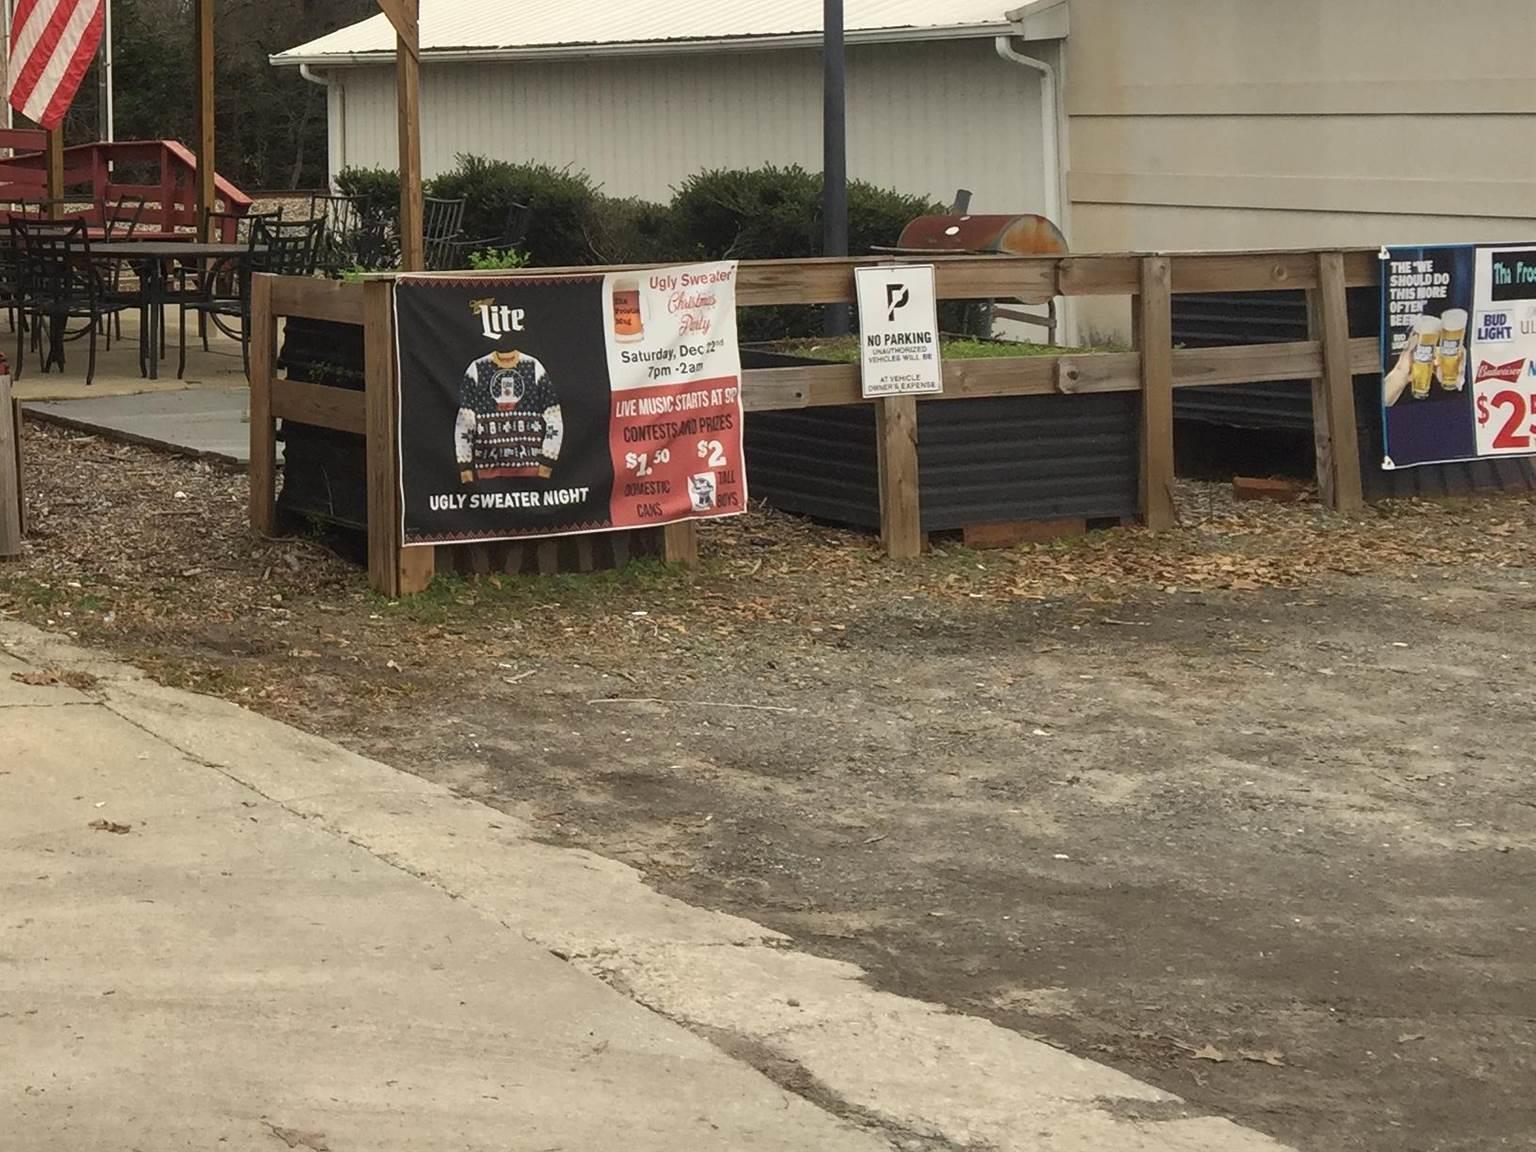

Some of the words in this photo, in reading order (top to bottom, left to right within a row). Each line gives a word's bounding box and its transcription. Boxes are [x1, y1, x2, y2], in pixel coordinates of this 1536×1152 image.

[1390, 261, 1412, 274] THE
[649, 274, 677, 291] Ugly
[681, 270, 732, 287] Sweater
[1390, 273, 1432, 287] SHOULD
[1433, 272, 1450, 285] DO
[1390, 287, 1416, 300] THIS
[1416, 286, 1447, 299] MORE
[479, 304, 525, 340] Lite
[1484, 313, 1507, 327] BUD
[867, 334, 881, 347] NO
[884, 331, 932, 346] PARKING
[1477, 326, 1512, 341] LIGHT
[621, 348, 677, 364] Saturday,
[679, 345, 704, 358] Dec
[872, 346, 928, 355] UNAUTHORIZED
[868, 355, 901, 363] VEHICLES
[648, 366, 671, 380] 7pm
[889, 374, 920, 382] VEHICLE
[616, 399, 637, 418] LIVE
[638, 396, 674, 416] MUSIC
[675, 390, 709, 412] STARTS
[711, 389, 723, 406] AT
[624, 421, 678, 443] CONTESTS
[699, 414, 733, 434] PRIZES
[697, 439, 727, 468] $2
[718, 470, 736, 485] TALL
[624, 480, 670, 497] DOMESTIC
[429, 494, 466, 511] UGLY
[469, 491, 540, 510] SWEATER
[543, 487, 589, 506] NIGHT
[637, 503, 663, 518] CANS
